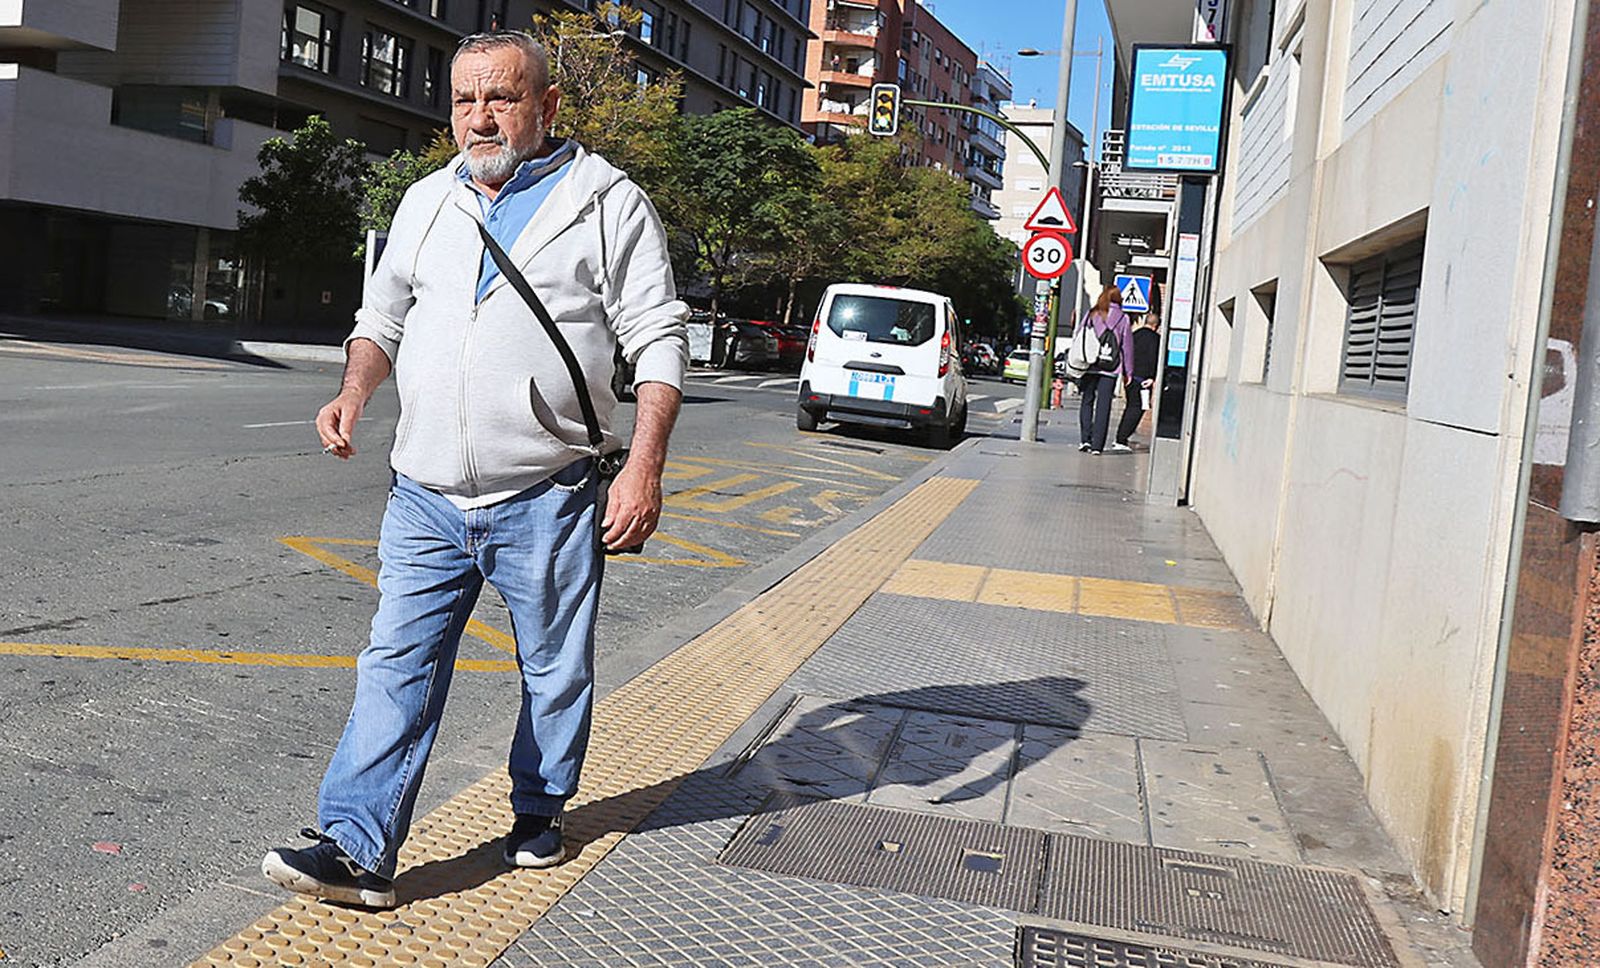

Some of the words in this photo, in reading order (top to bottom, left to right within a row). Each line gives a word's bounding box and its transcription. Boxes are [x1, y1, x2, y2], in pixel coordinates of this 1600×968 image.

[1141, 74, 1216, 87] EMTUSA
[1184, 124, 1219, 133] SEVILLA
[1033, 247, 1061, 264] 30
